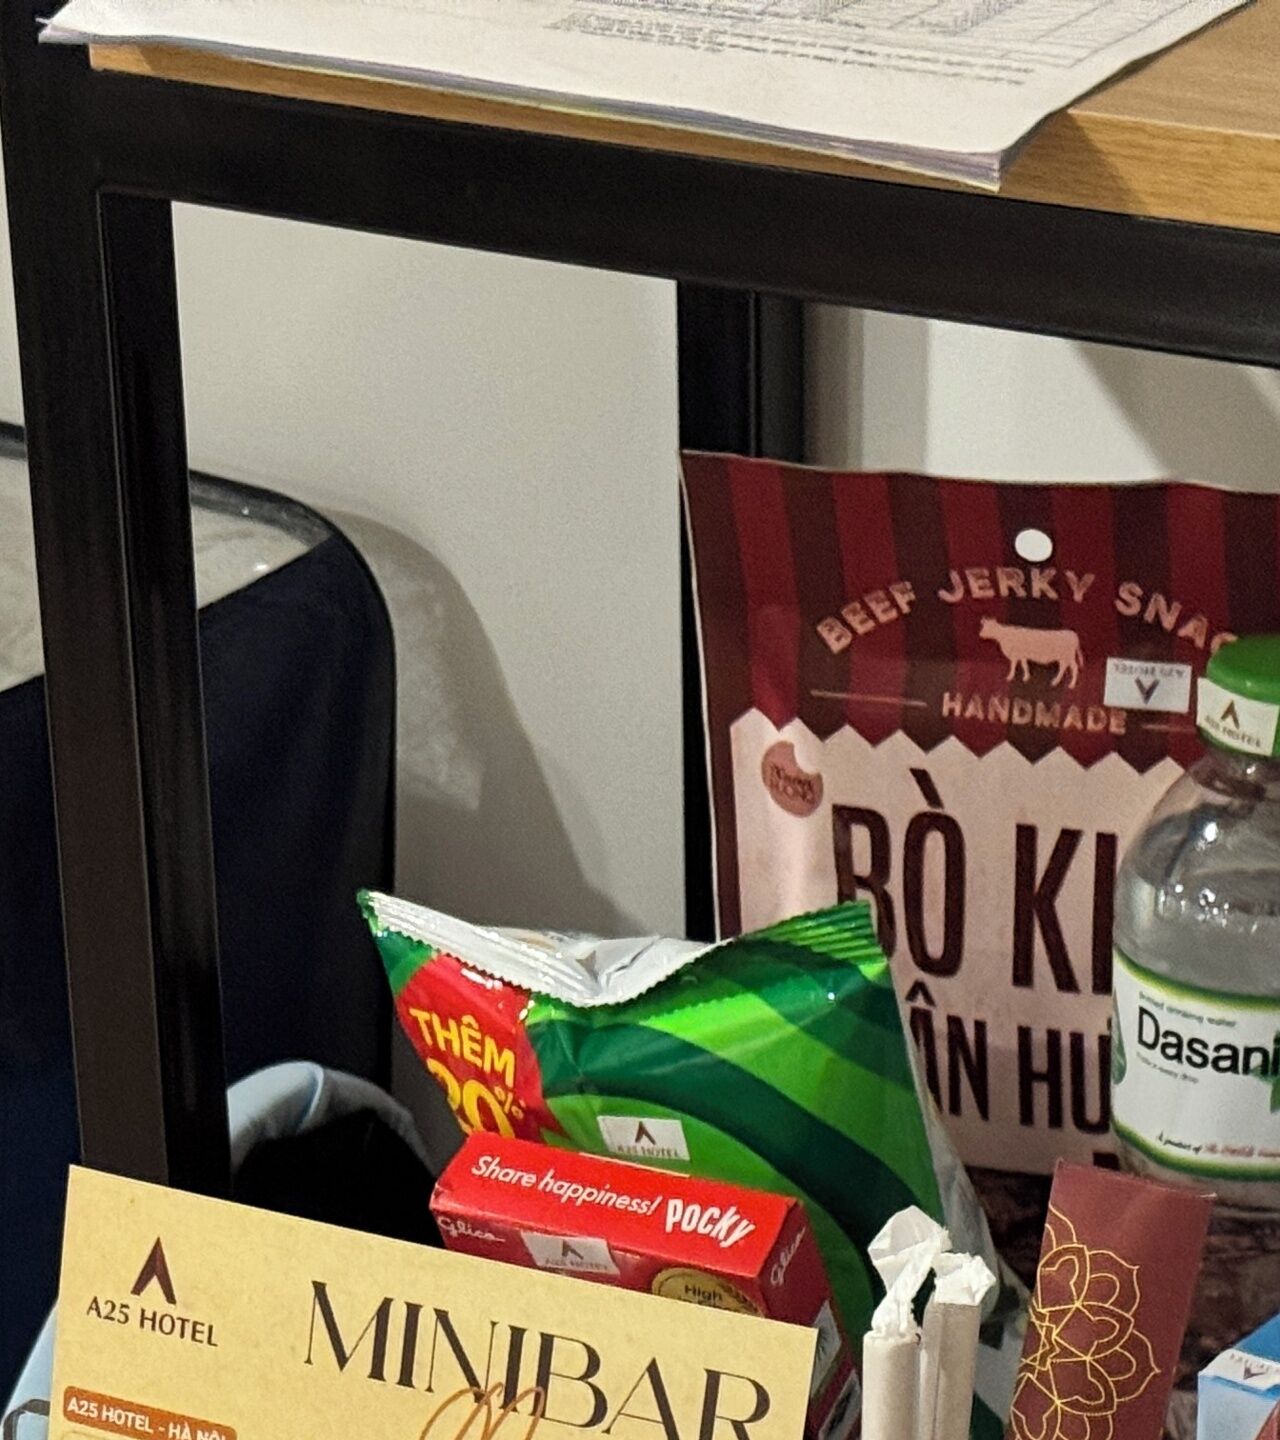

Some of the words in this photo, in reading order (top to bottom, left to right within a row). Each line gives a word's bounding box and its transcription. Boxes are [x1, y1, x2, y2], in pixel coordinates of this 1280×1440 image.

[817, 580, 918, 655] BEEF
[938, 567, 1096, 604] JERKY
[942, 691, 1128, 737] HANDMADE
[830, 766, 966, 978] BÒ
[409, 1008, 516, 1088] THÊM
[471, 1155, 537, 1188] Share
[539, 1168, 663, 1216] happiness!
[665, 1198, 756, 1248] POCKY
[86, 1295, 131, 1325] A25
[138, 1307, 219, 1348] HOTEL
[67, 1396, 99, 1419] A25
[102, 1403, 154, 1434] HOTEL
